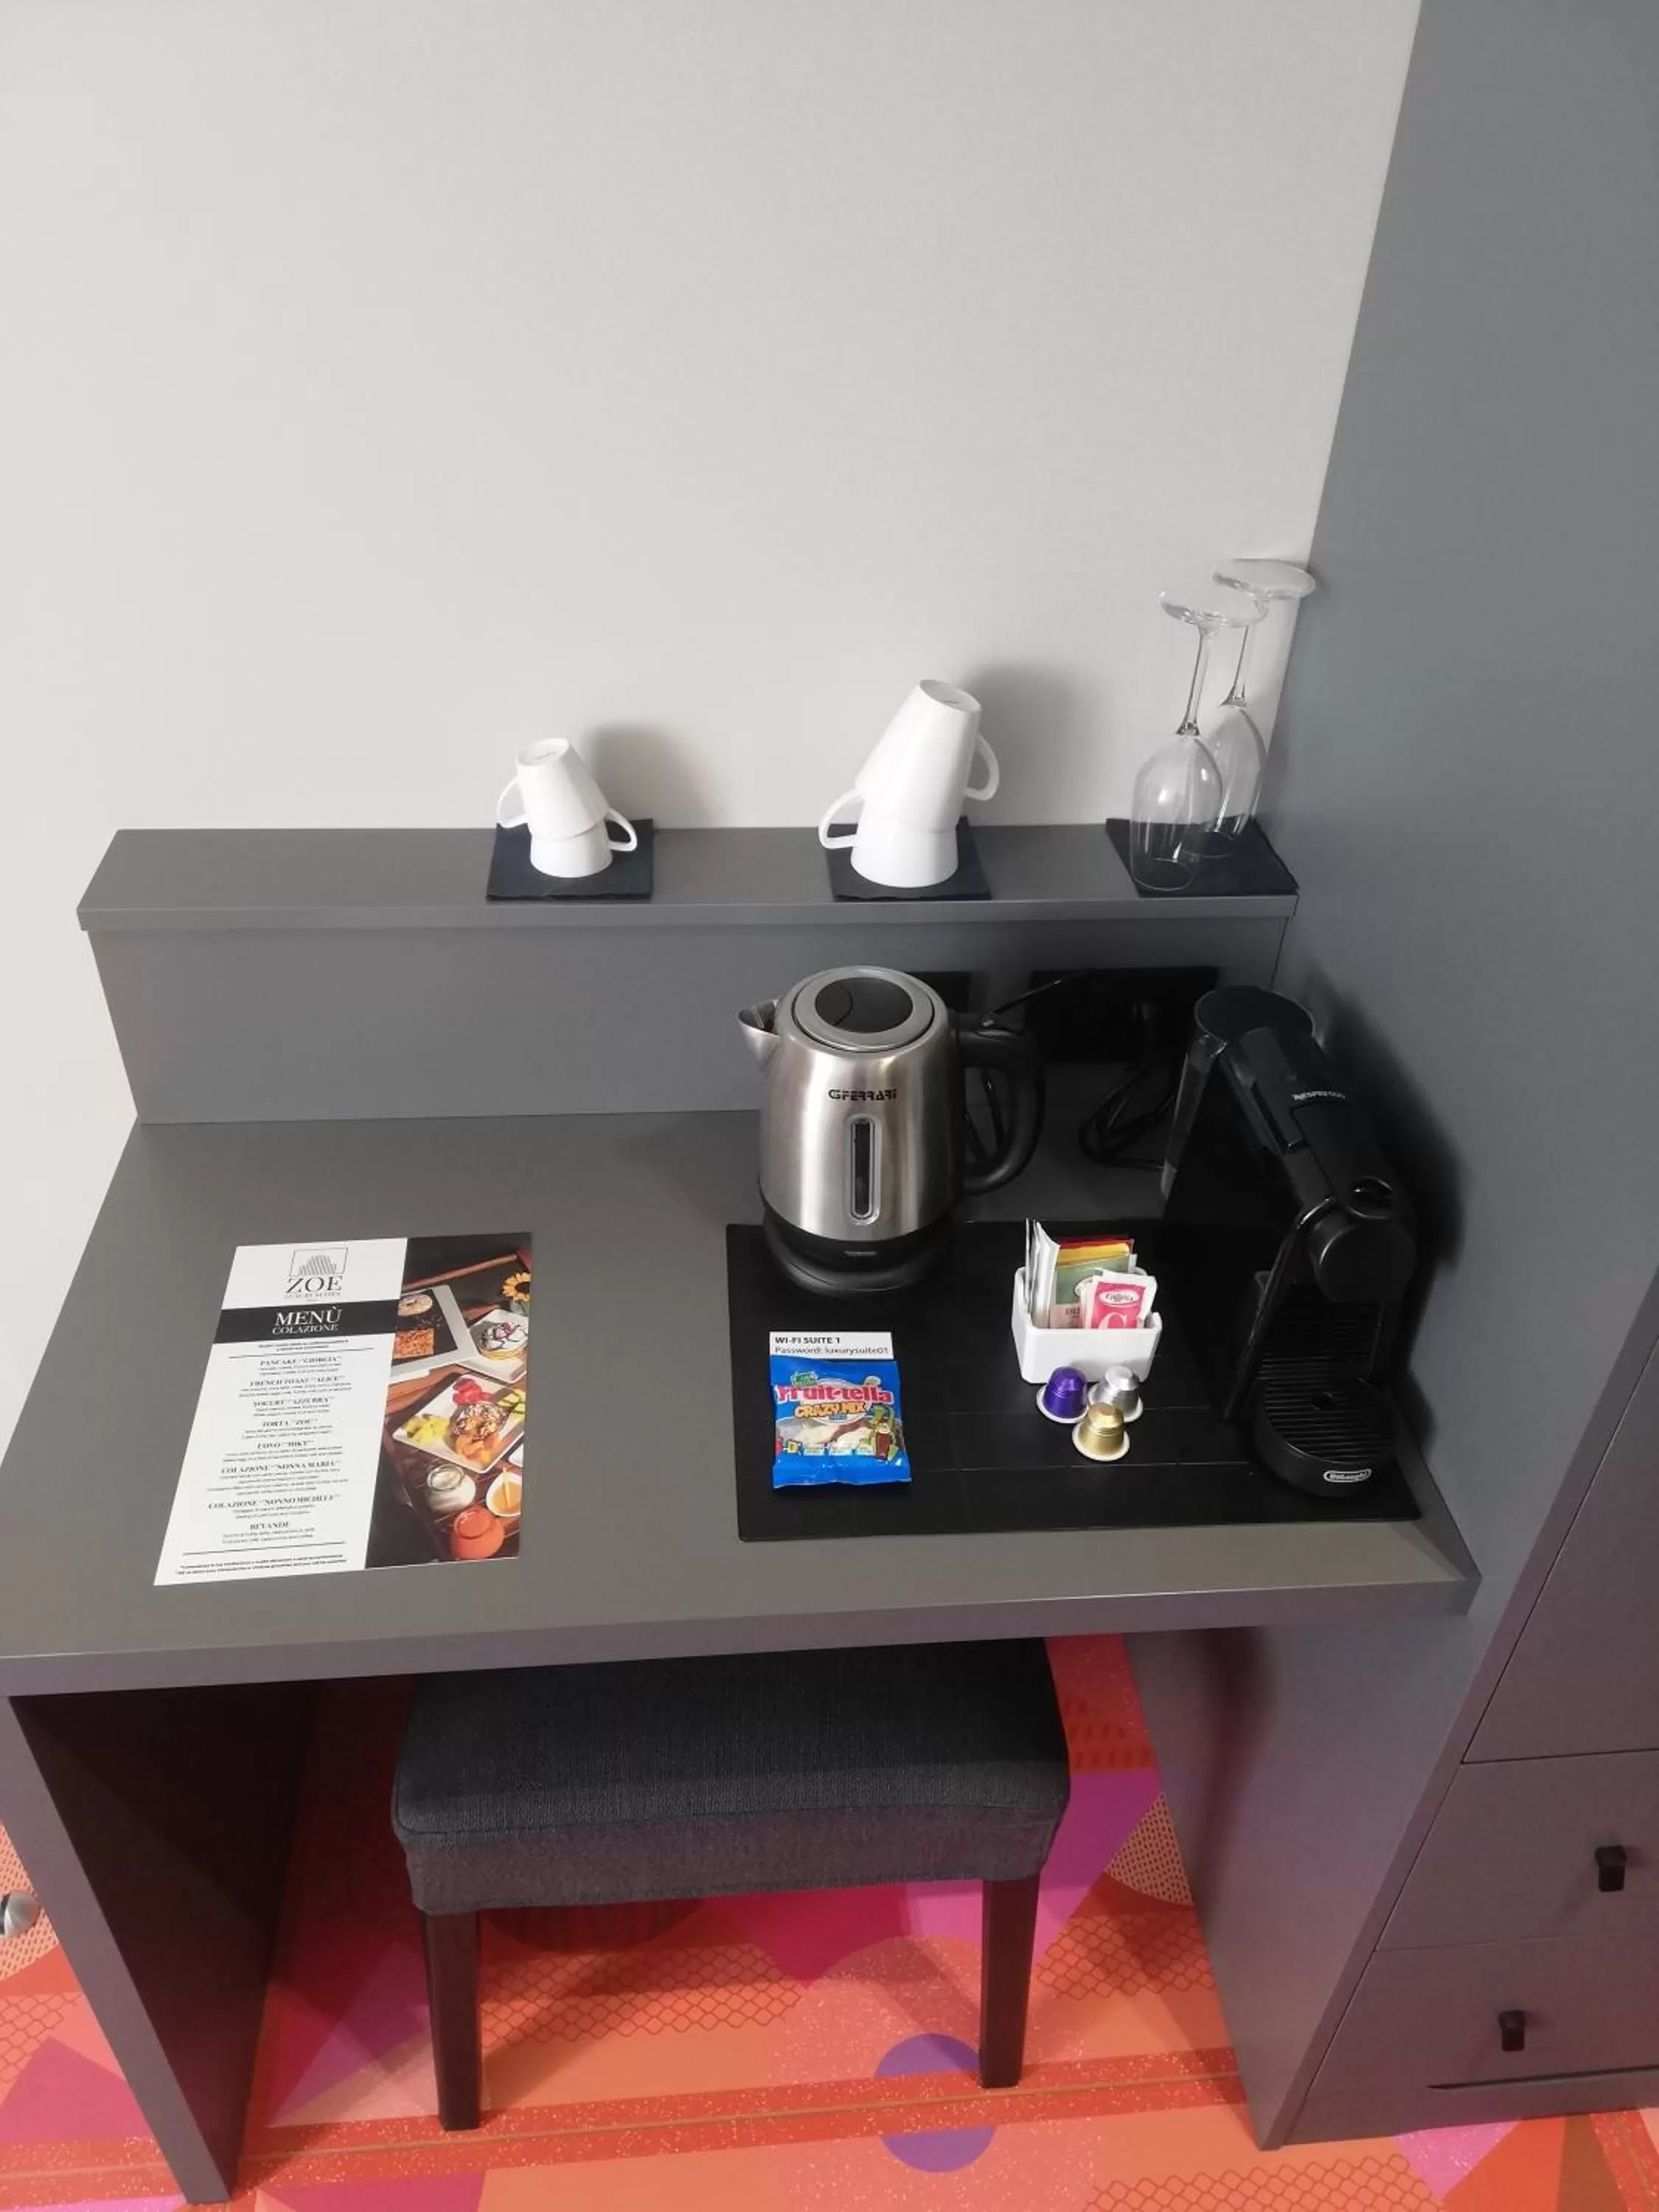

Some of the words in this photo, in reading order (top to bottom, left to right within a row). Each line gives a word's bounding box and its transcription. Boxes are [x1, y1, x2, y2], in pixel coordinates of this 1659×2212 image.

[285, 1276, 343, 1293] ZOE
[274, 1305, 343, 1326] MENÙ
[271, 1324, 339, 1335] COLAZIONE
[775, 1346, 823, 1354] Password:
[825, 1346, 888, 1356] luxurysuite01
[796, 1402, 840, 1418] CRAZY
[841, 1401, 867, 1413] MIX
